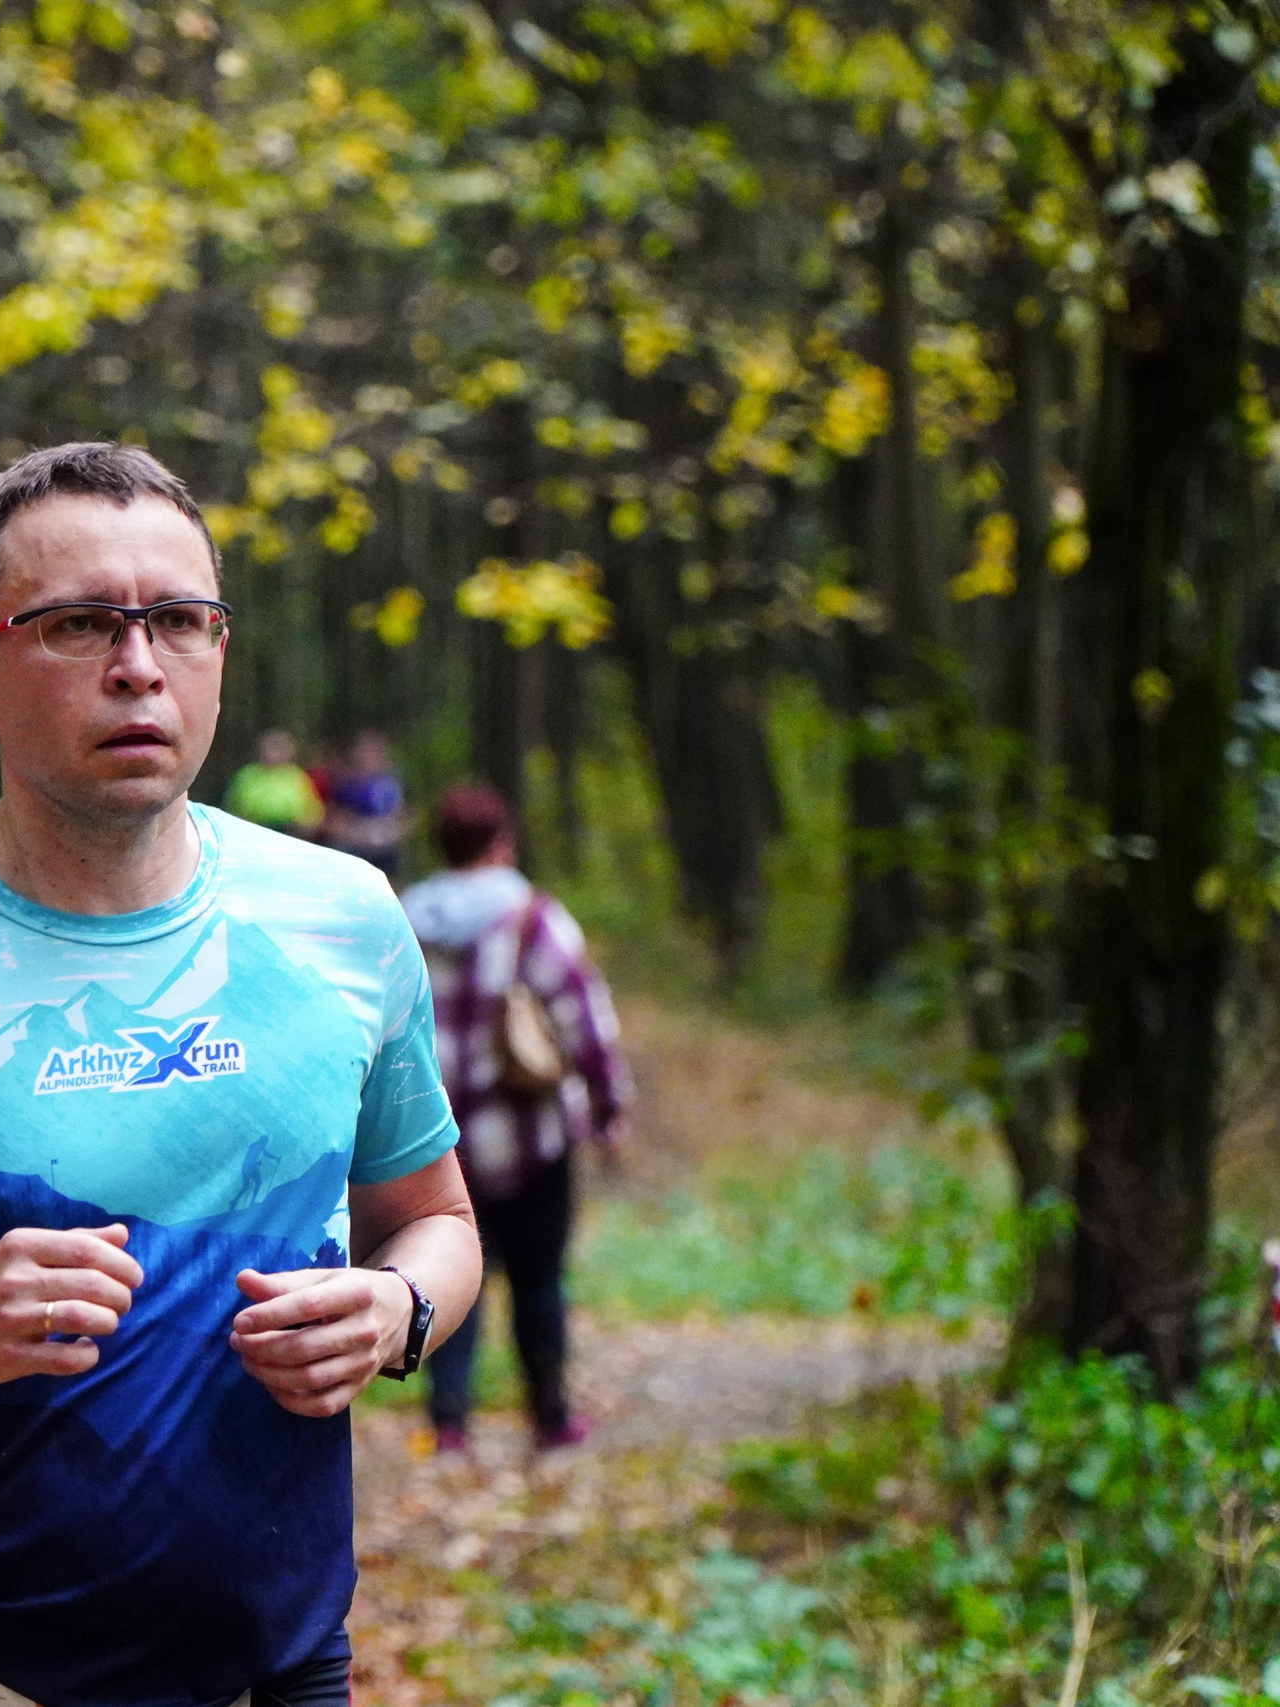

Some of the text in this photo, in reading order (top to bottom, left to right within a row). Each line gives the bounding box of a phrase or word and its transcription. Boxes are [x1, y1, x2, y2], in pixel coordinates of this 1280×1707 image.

[45, 1047, 144, 1077] Arkhyz
[191, 1042, 240, 1062] run
[201, 1061, 241, 1074] TRAIL
[38, 1072, 126, 1092] ALPINDUSTRIA
